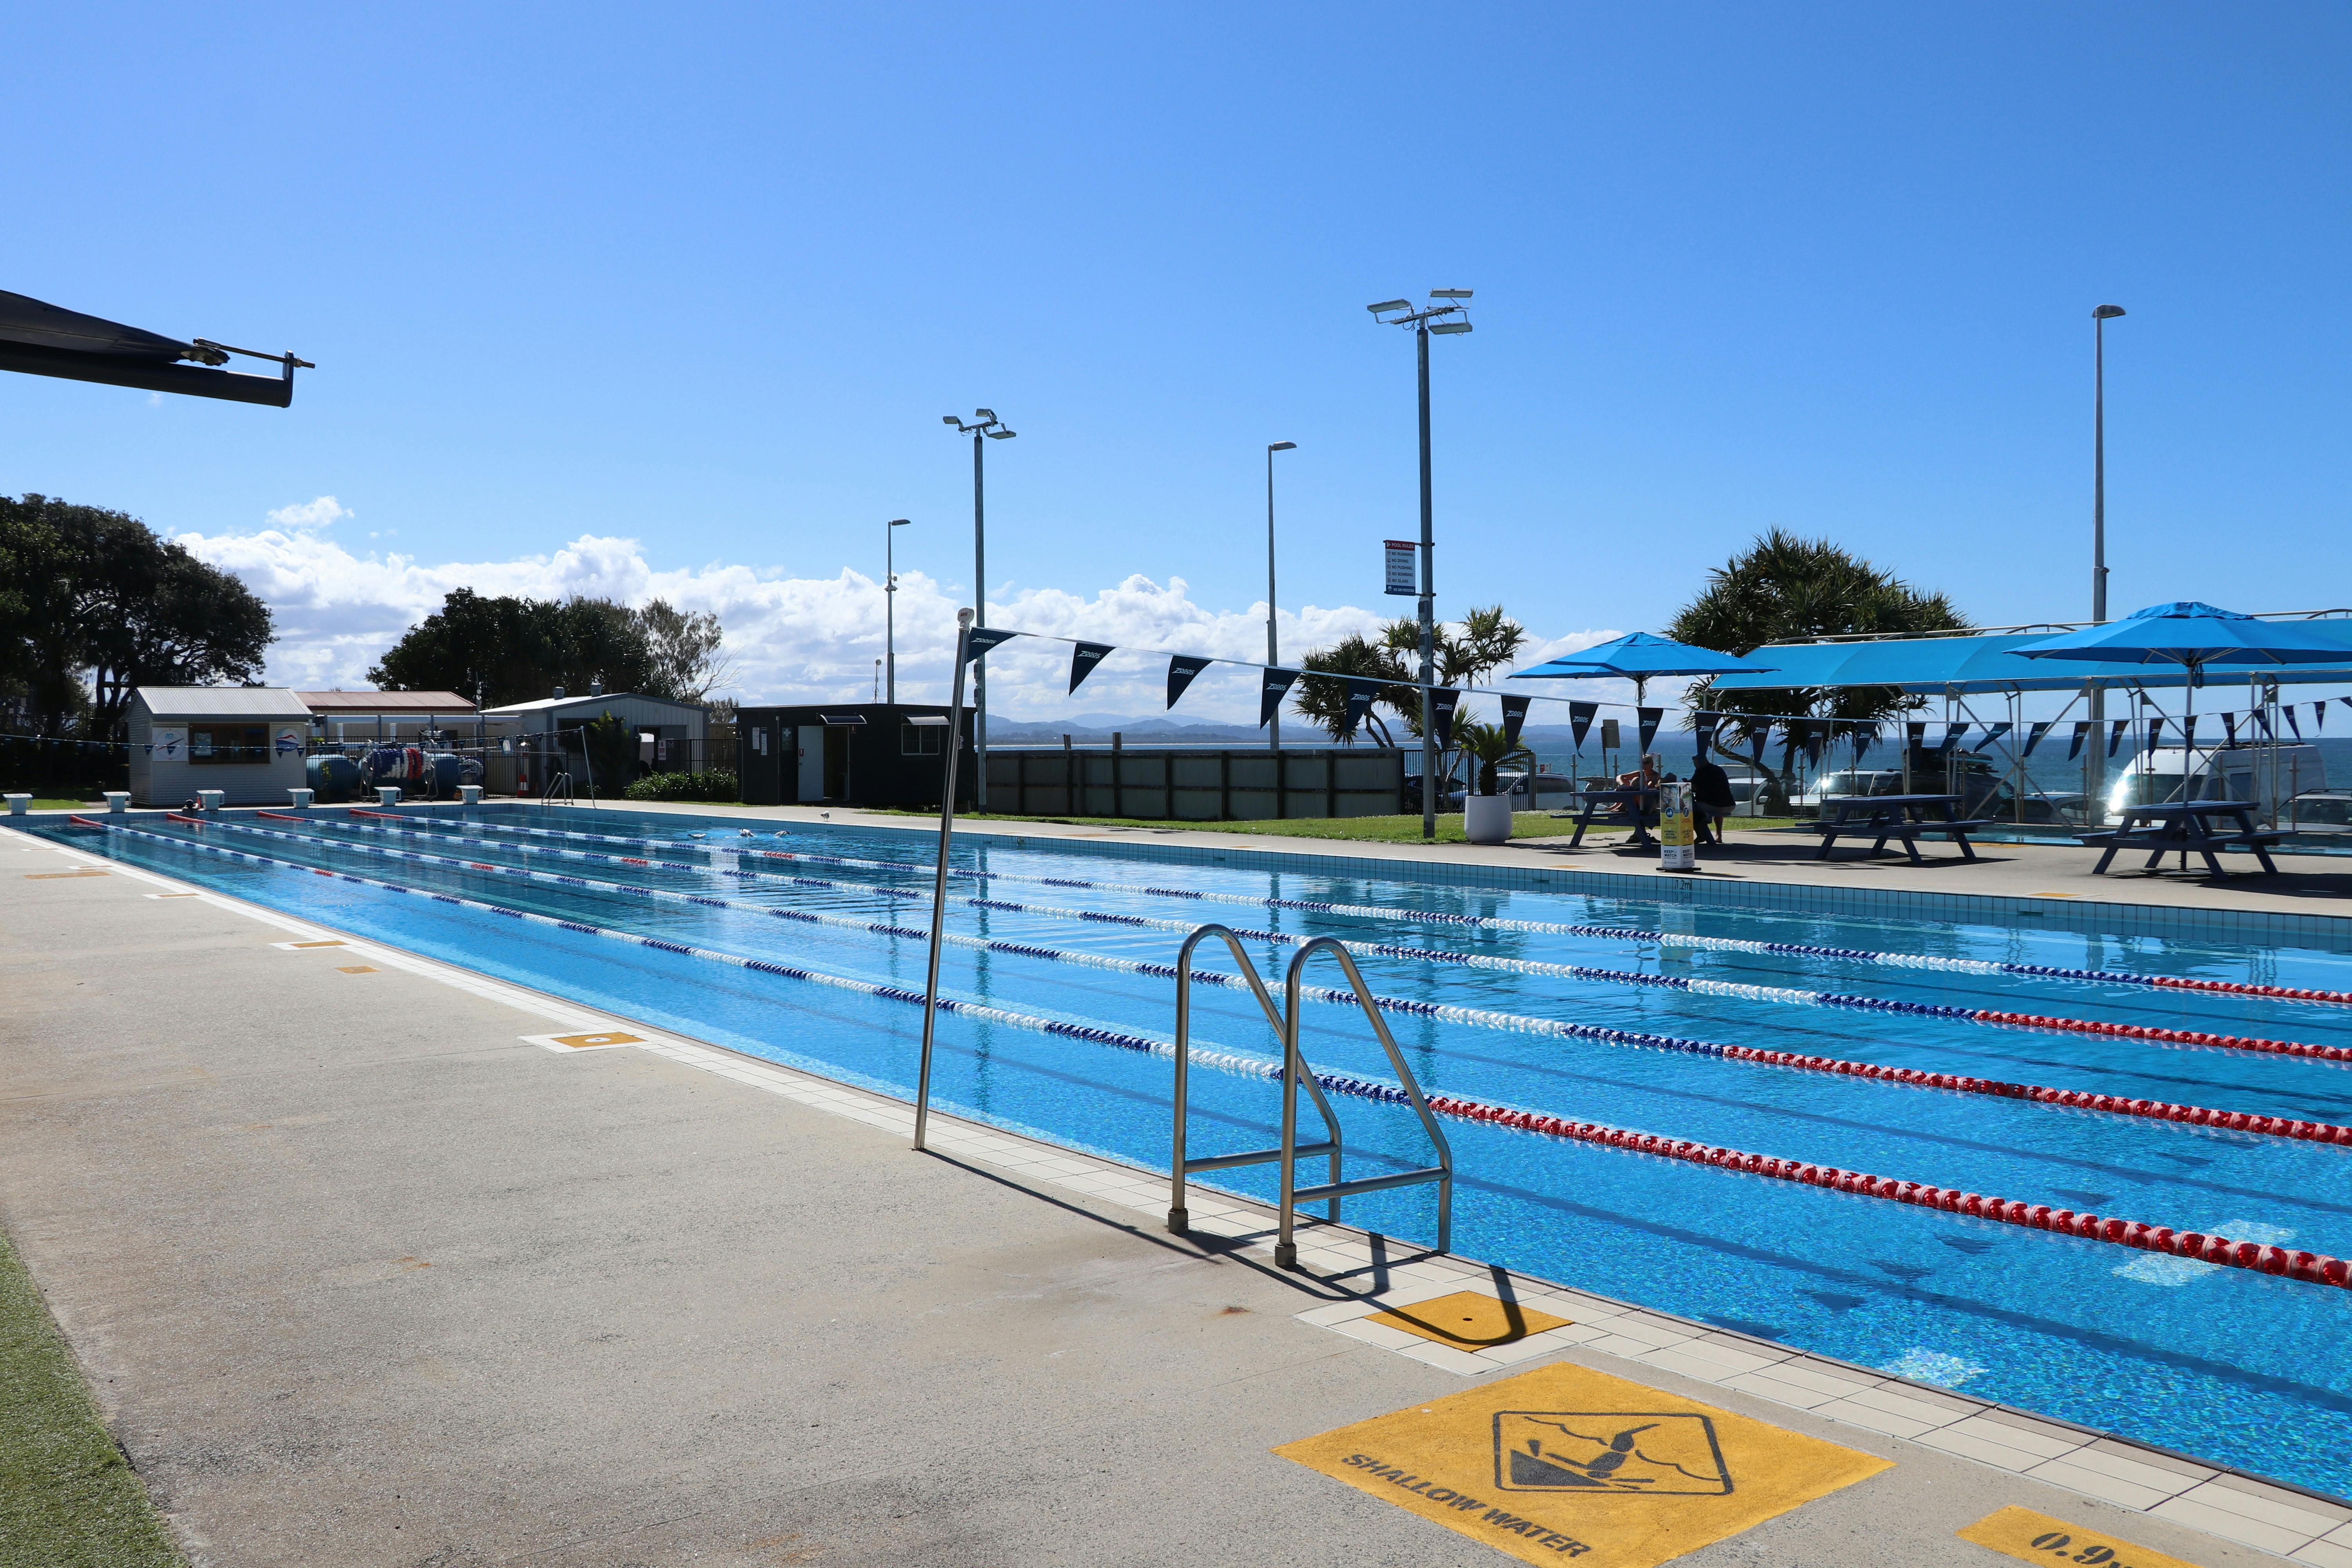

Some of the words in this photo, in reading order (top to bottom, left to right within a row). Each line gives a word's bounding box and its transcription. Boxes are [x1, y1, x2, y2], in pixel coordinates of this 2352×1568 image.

[1676, 880, 1691, 890] 1.2m
[1341, 1453, 1487, 1511] SHALLOW
[1481, 1508, 1592, 1558] WATER
